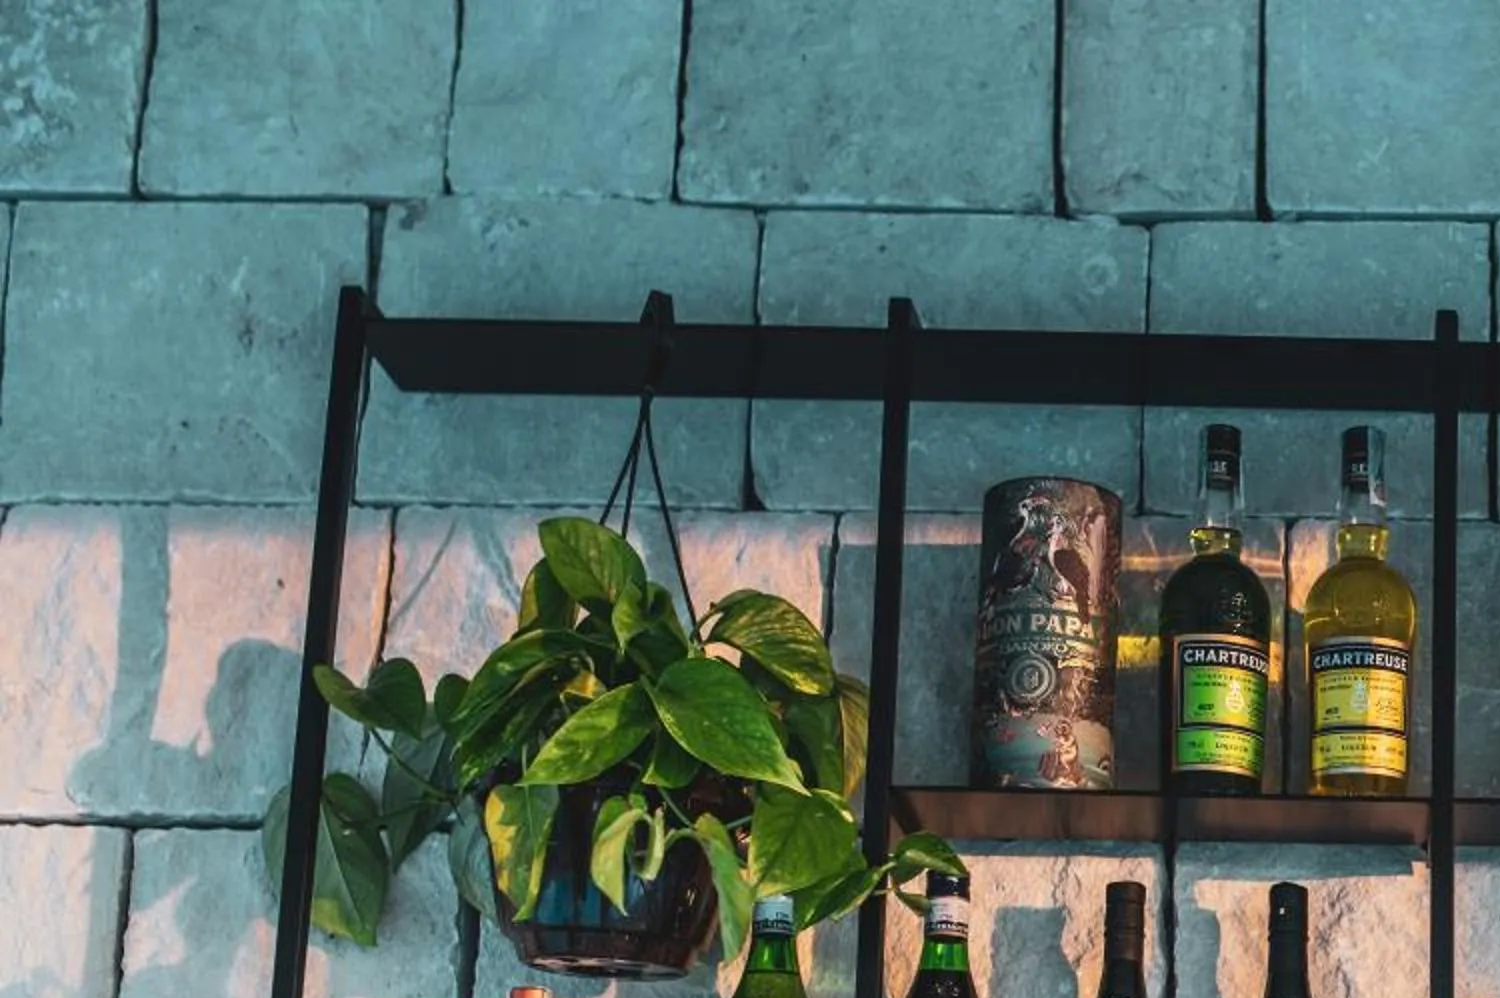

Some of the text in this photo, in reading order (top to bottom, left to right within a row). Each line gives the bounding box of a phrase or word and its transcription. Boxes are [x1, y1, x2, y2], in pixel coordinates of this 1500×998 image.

[1031, 613, 1095, 639] PAPA
[1183, 648, 1267, 674] CHARTREUS
[1313, 651, 1408, 672] CHARTREUSE
